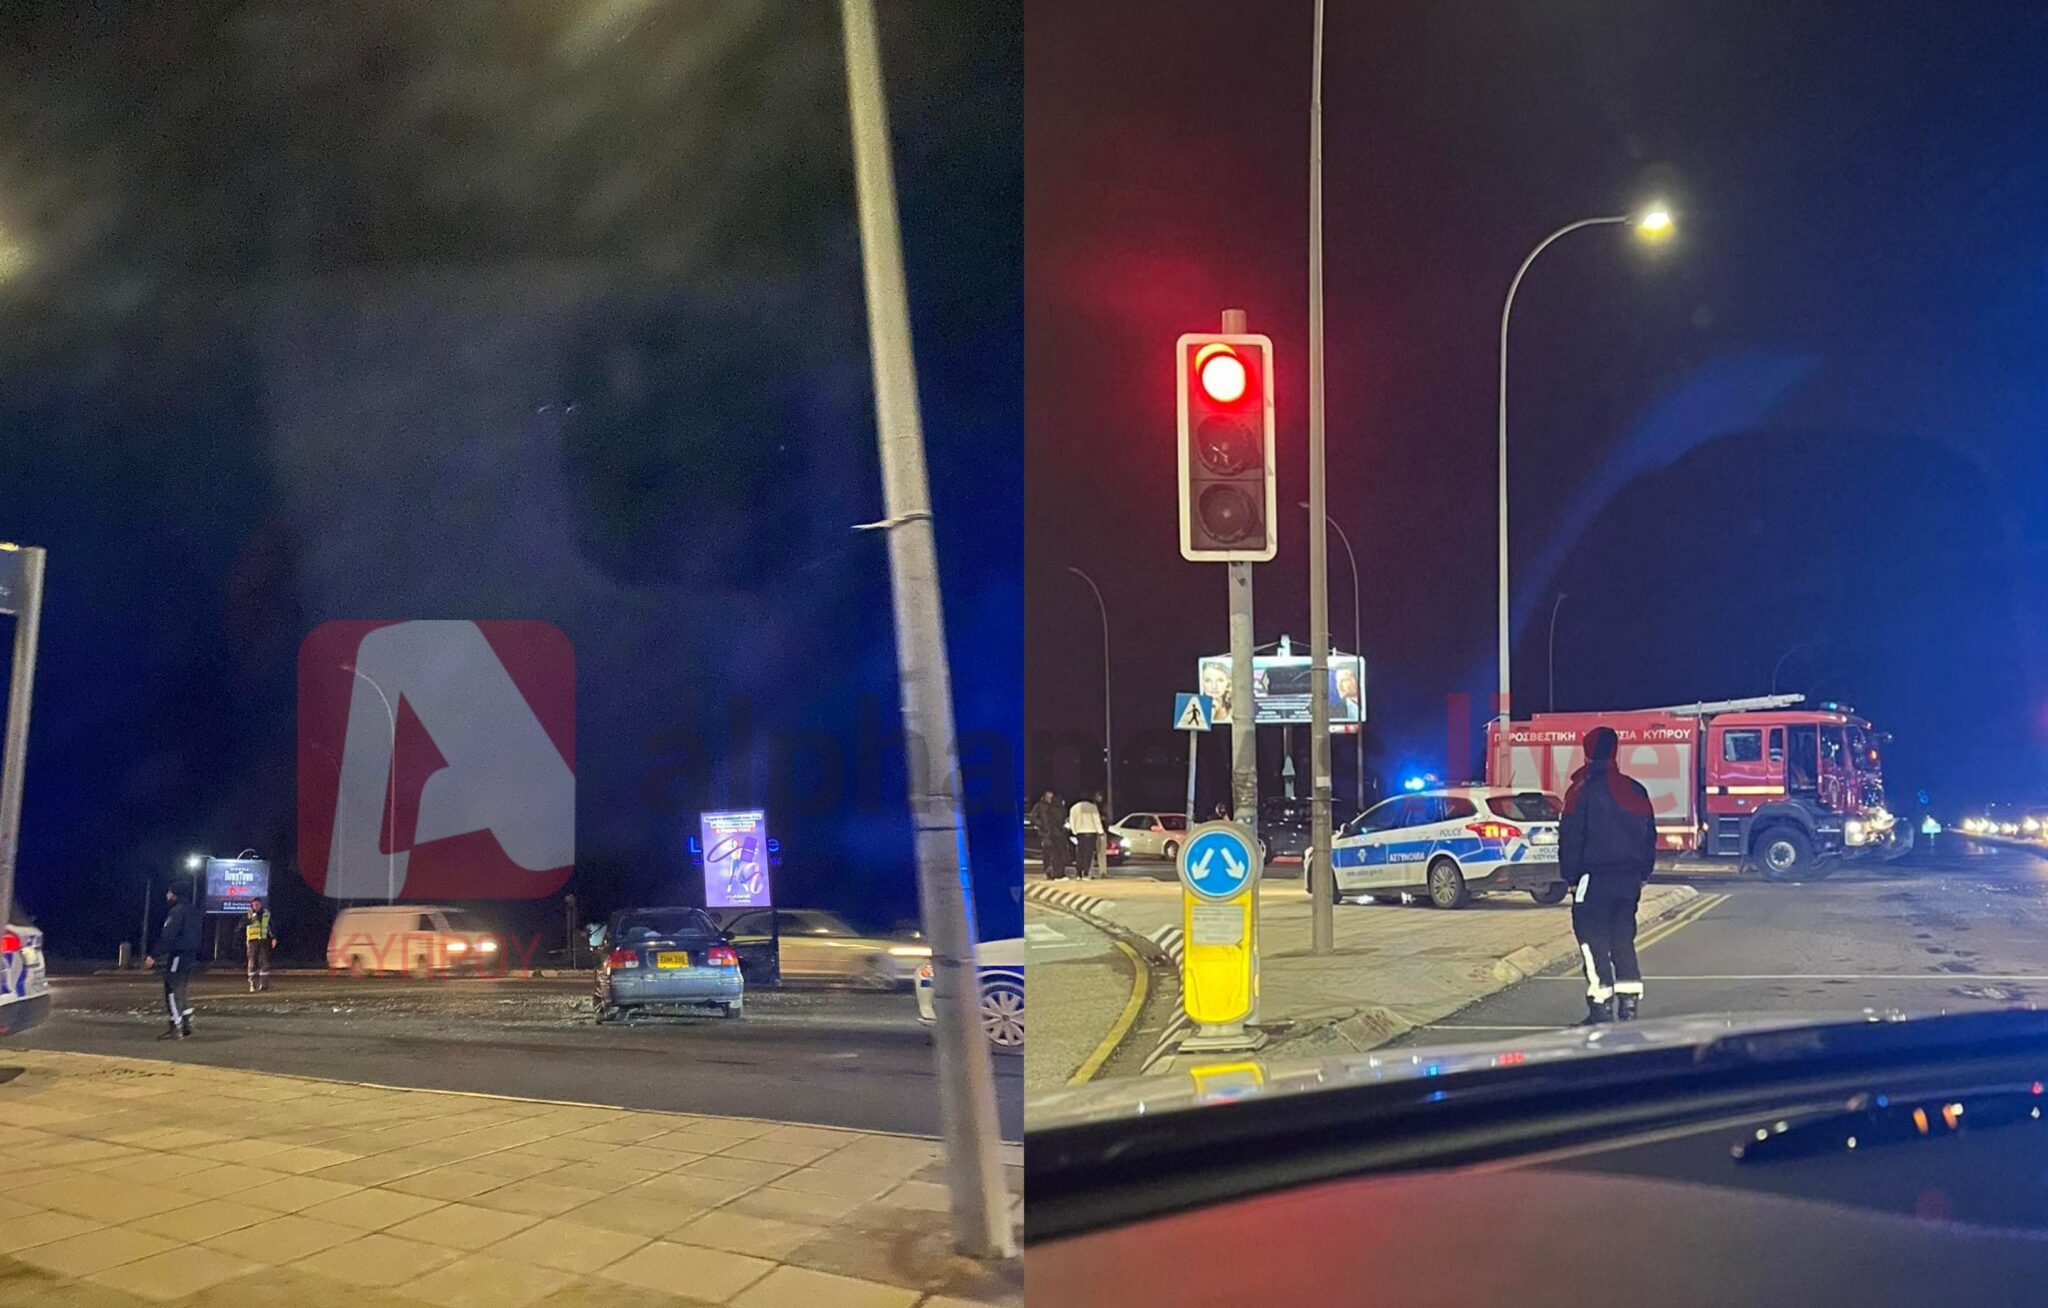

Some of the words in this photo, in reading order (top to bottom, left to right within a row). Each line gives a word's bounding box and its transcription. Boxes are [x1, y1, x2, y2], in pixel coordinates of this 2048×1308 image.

[1494, 731, 1576, 742] ΠΡΟΣΒΕΣΤΙΚΗ
[1643, 728, 1691, 740] ΚΥΠΡΟΥ
[1439, 827, 1462, 838] POLICE
